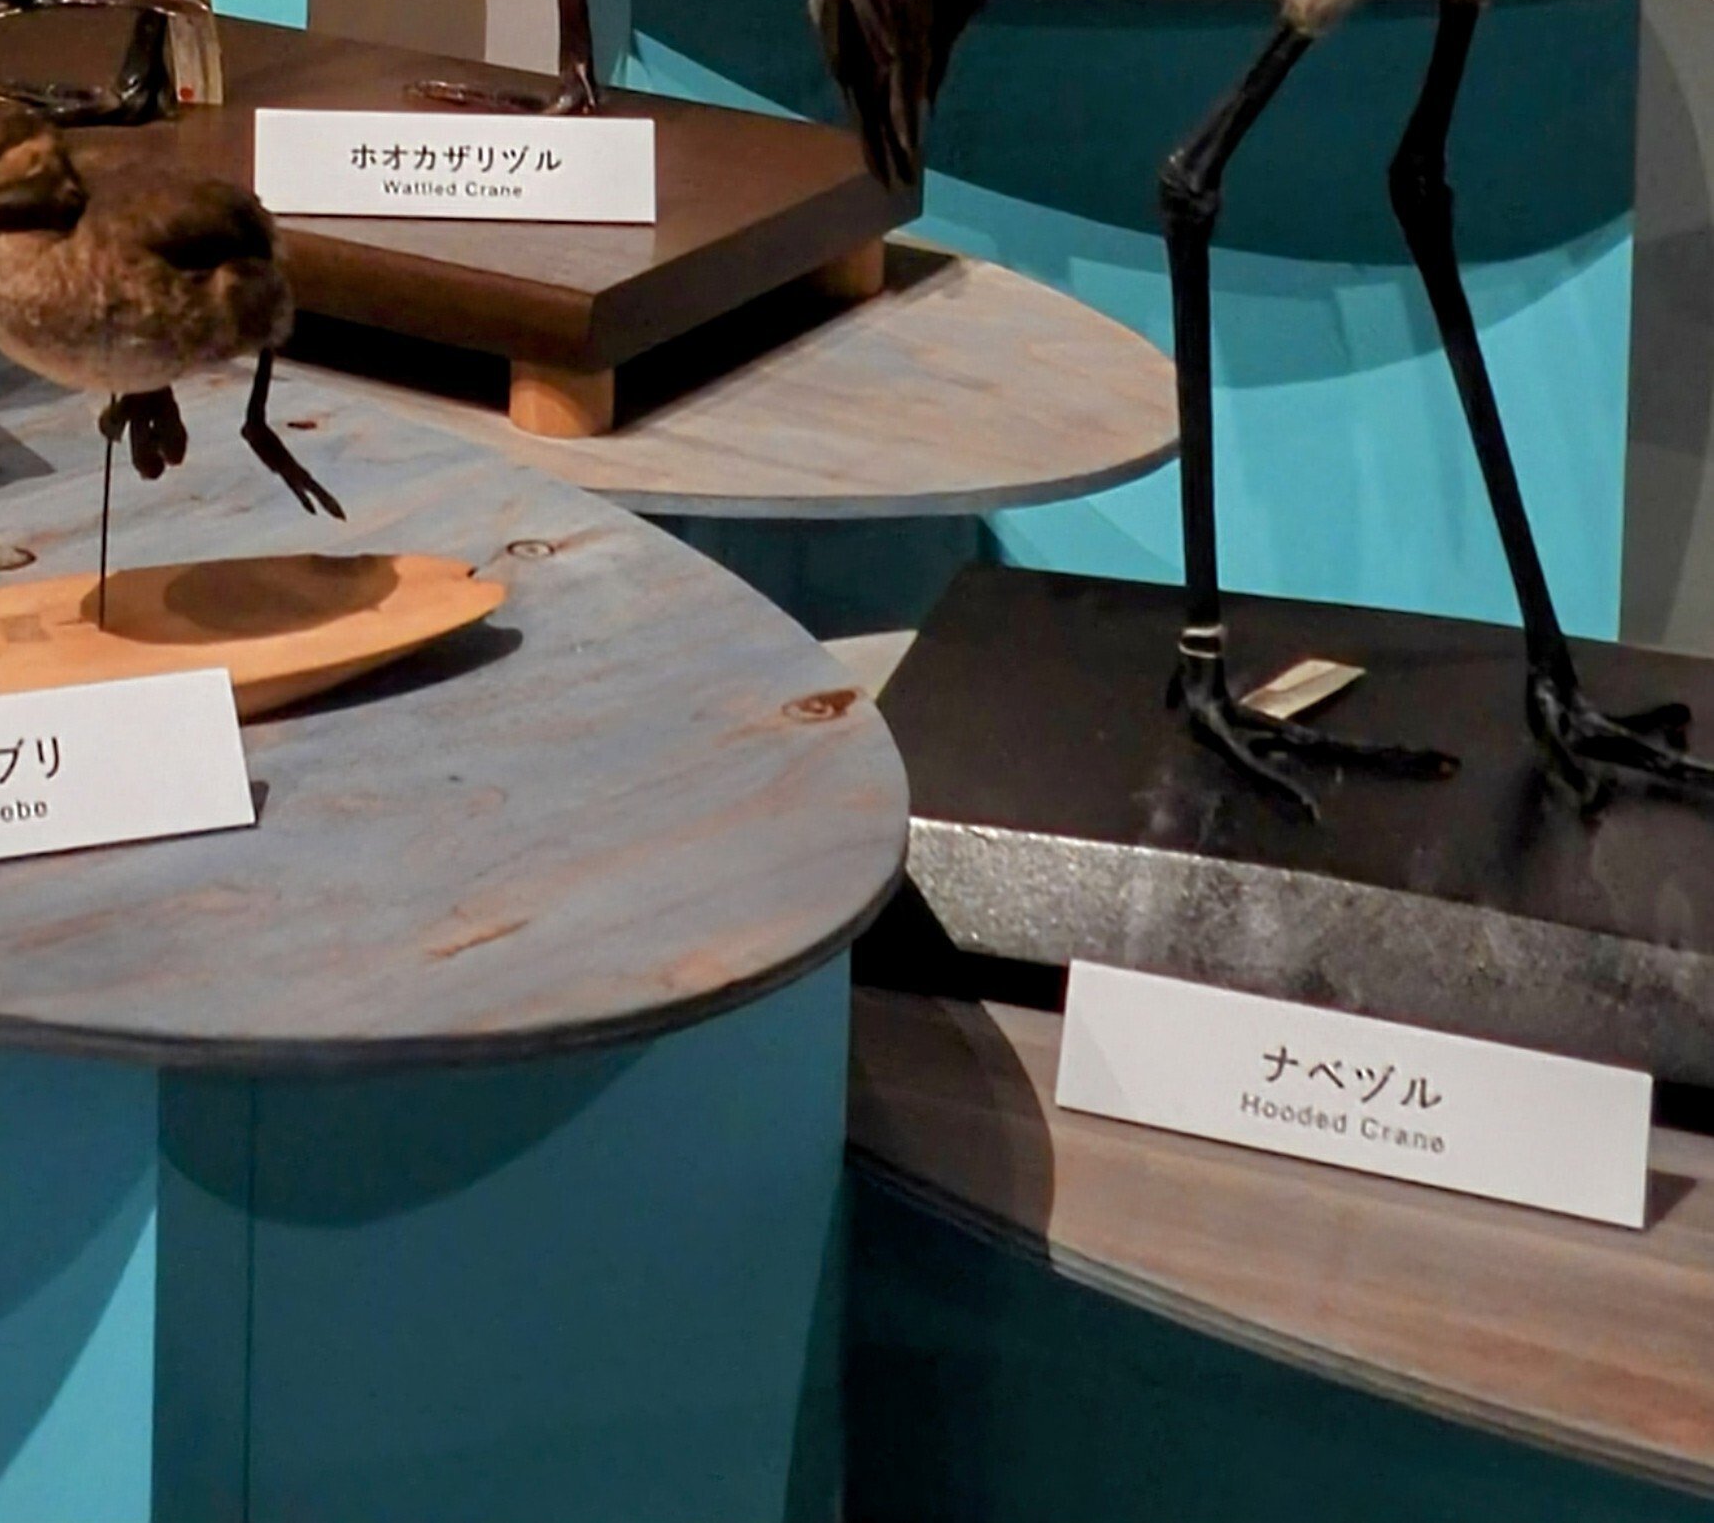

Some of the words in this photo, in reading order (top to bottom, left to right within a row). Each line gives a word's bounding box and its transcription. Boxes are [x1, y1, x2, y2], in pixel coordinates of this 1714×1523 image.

[350, 143, 562, 174] ホオカザリヅル
[383, 180, 457, 197] Wattled
[465, 181, 523, 198] Crane
[1262, 1045, 1443, 1112] ナベヅル
[1240, 1091, 1348, 1135] Hooded
[1360, 1116, 1447, 1155] Crane
